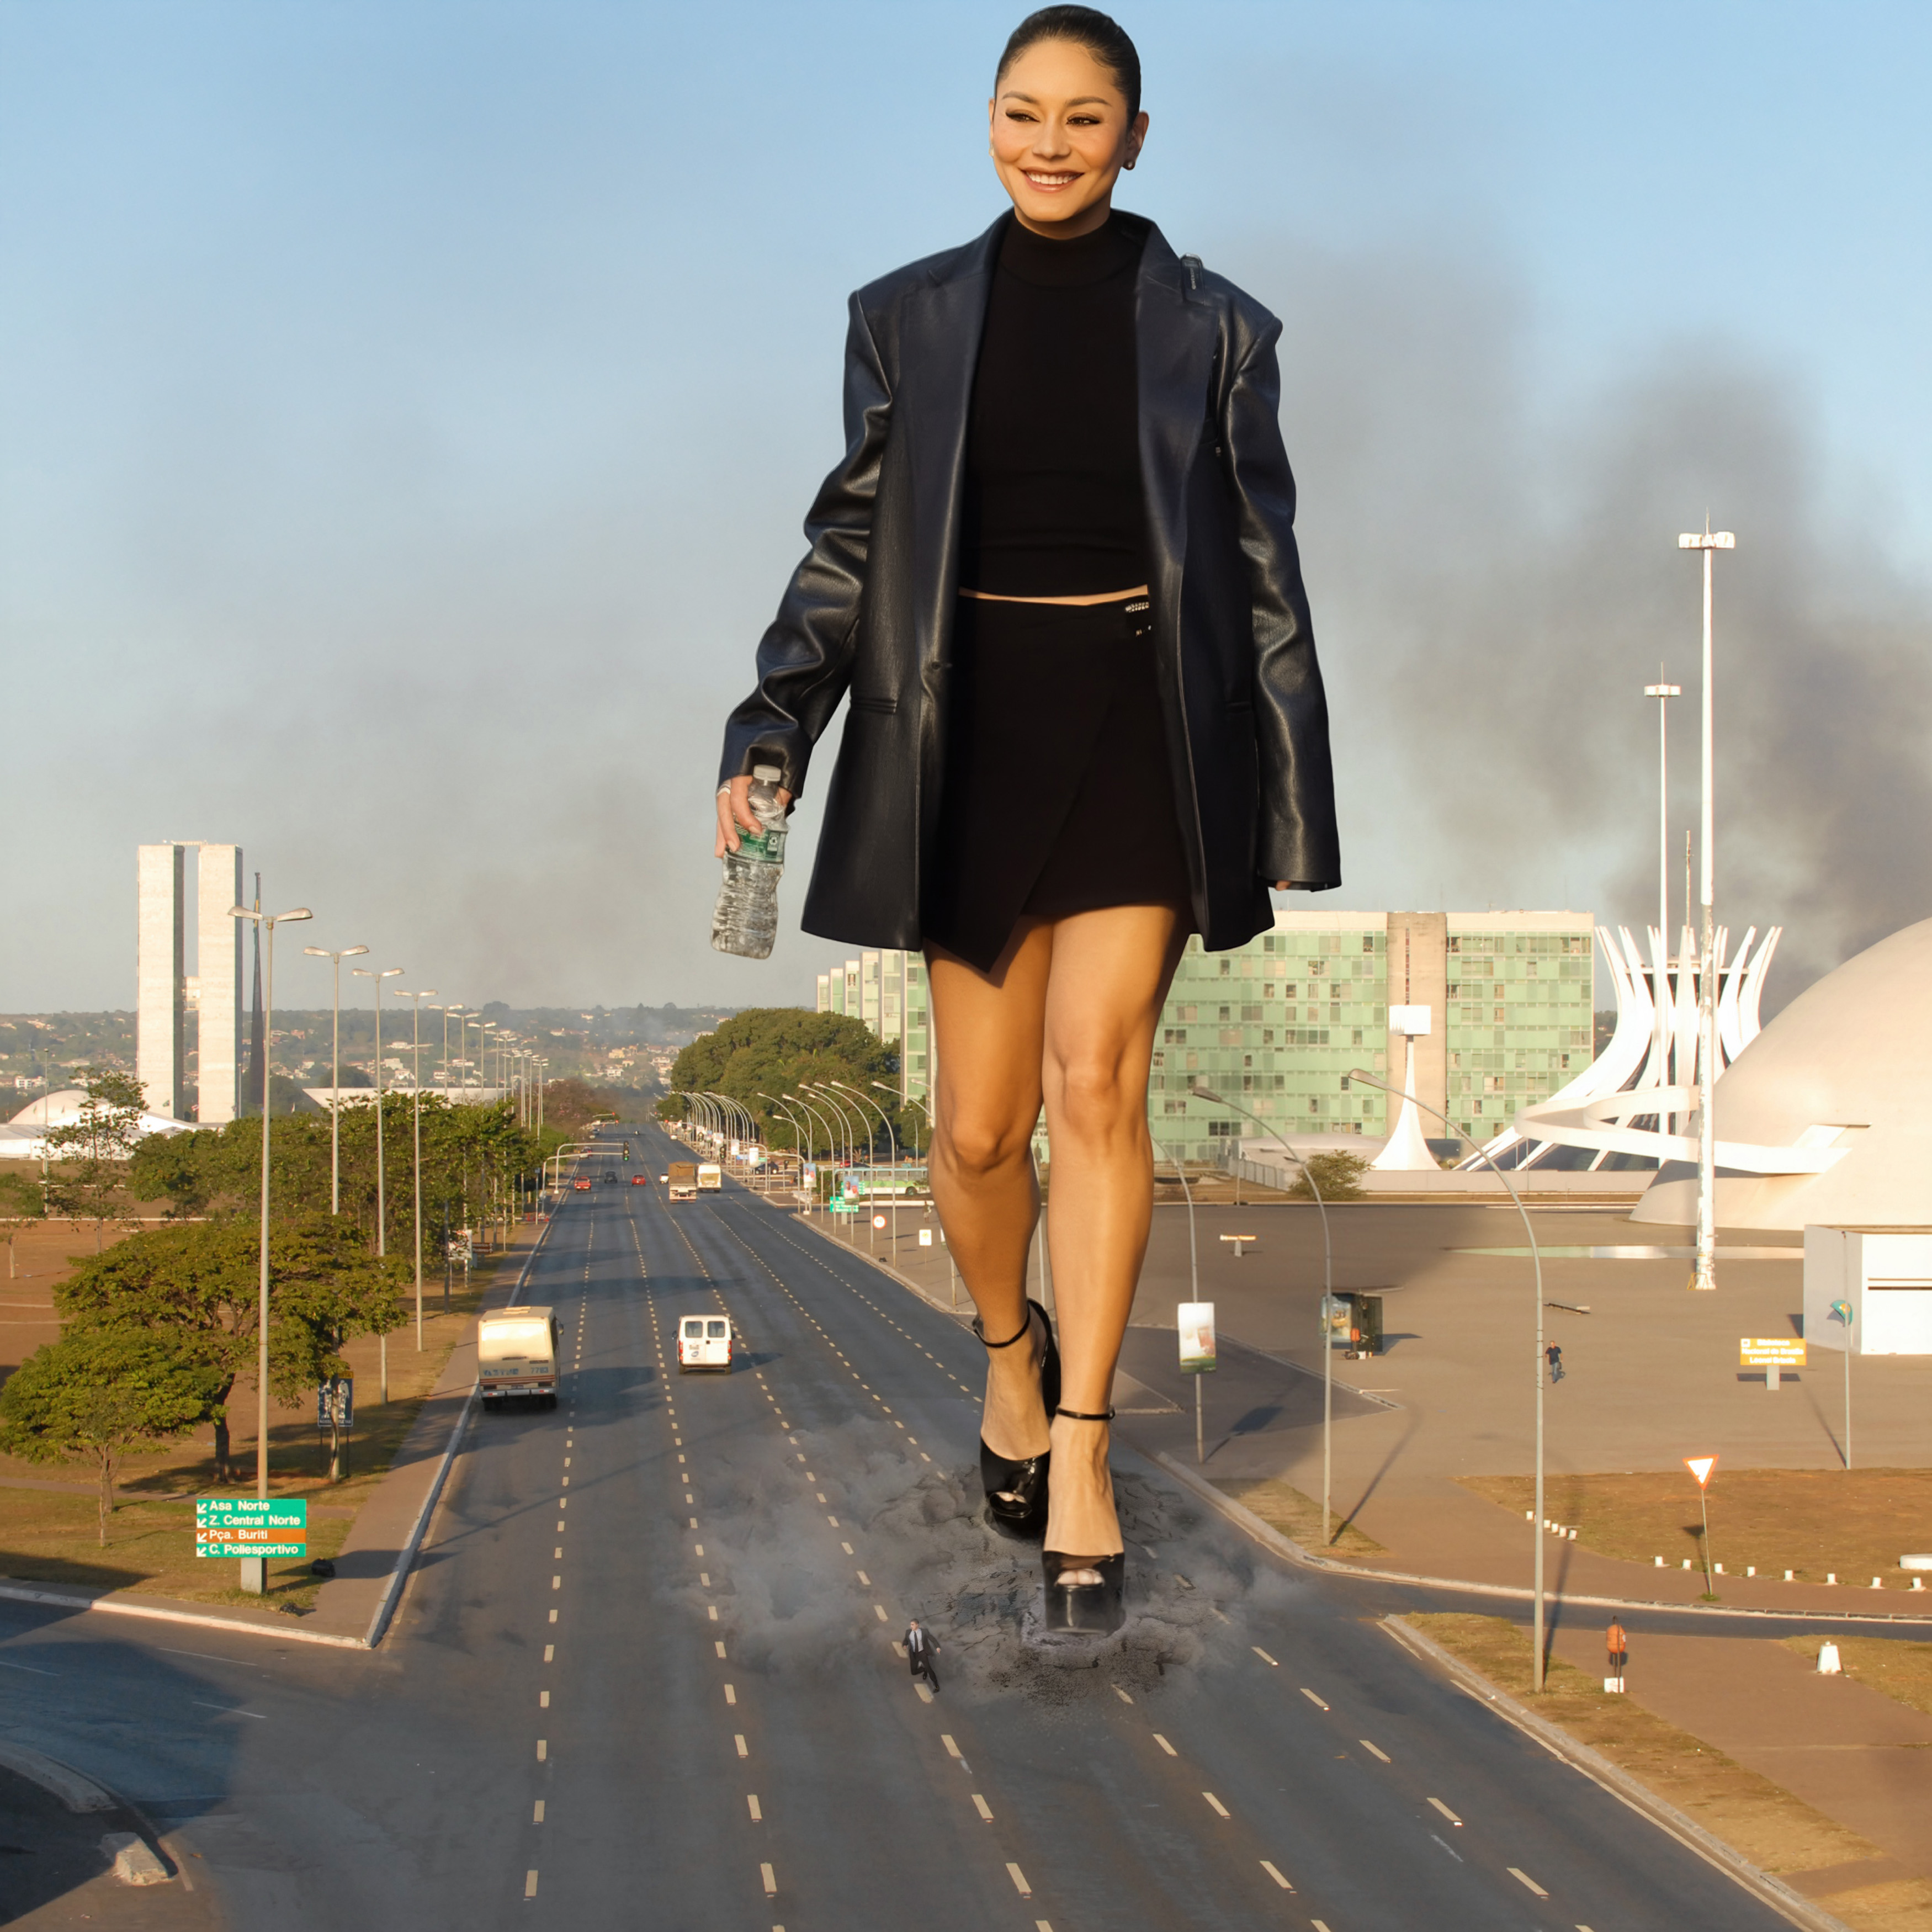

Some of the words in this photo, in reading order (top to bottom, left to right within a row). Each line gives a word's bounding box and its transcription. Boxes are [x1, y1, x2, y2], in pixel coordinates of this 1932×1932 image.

[209, 1500, 232, 1511] Asa
[238, 1500, 270, 1511] Norte
[209, 1515, 220, 1525] Z.
[223, 1515, 264, 1525] Central
[269, 1515, 301, 1525] Norte
[209, 1530, 233, 1542] Pça.
[238, 1530, 268, 1540] Buriti
[209, 1543, 220, 1554] C.
[224, 1544, 299, 1556] Poliesportivo
